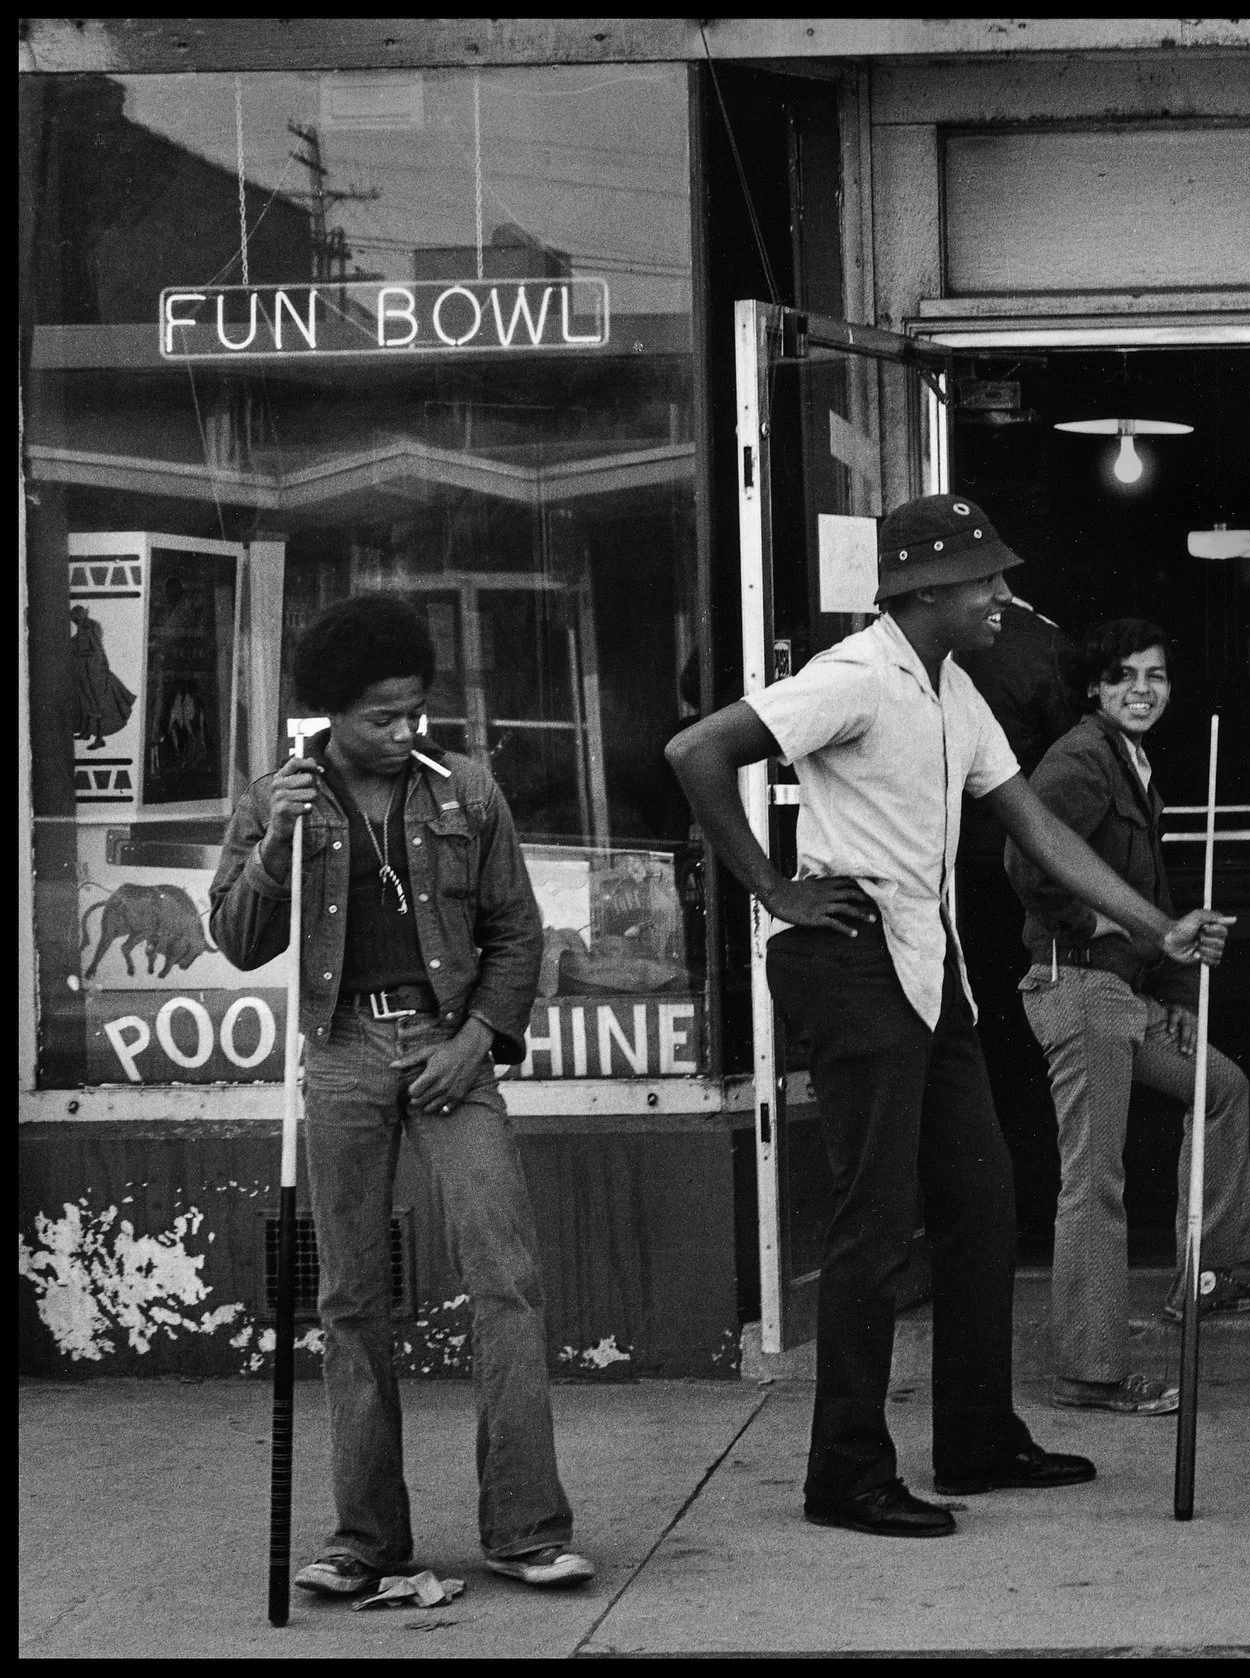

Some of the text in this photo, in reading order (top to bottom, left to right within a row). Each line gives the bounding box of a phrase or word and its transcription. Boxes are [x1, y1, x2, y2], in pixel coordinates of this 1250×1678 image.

[165, 285, 602, 353] FUN BOWL
[103, 996, 698, 1082] POO HINE
